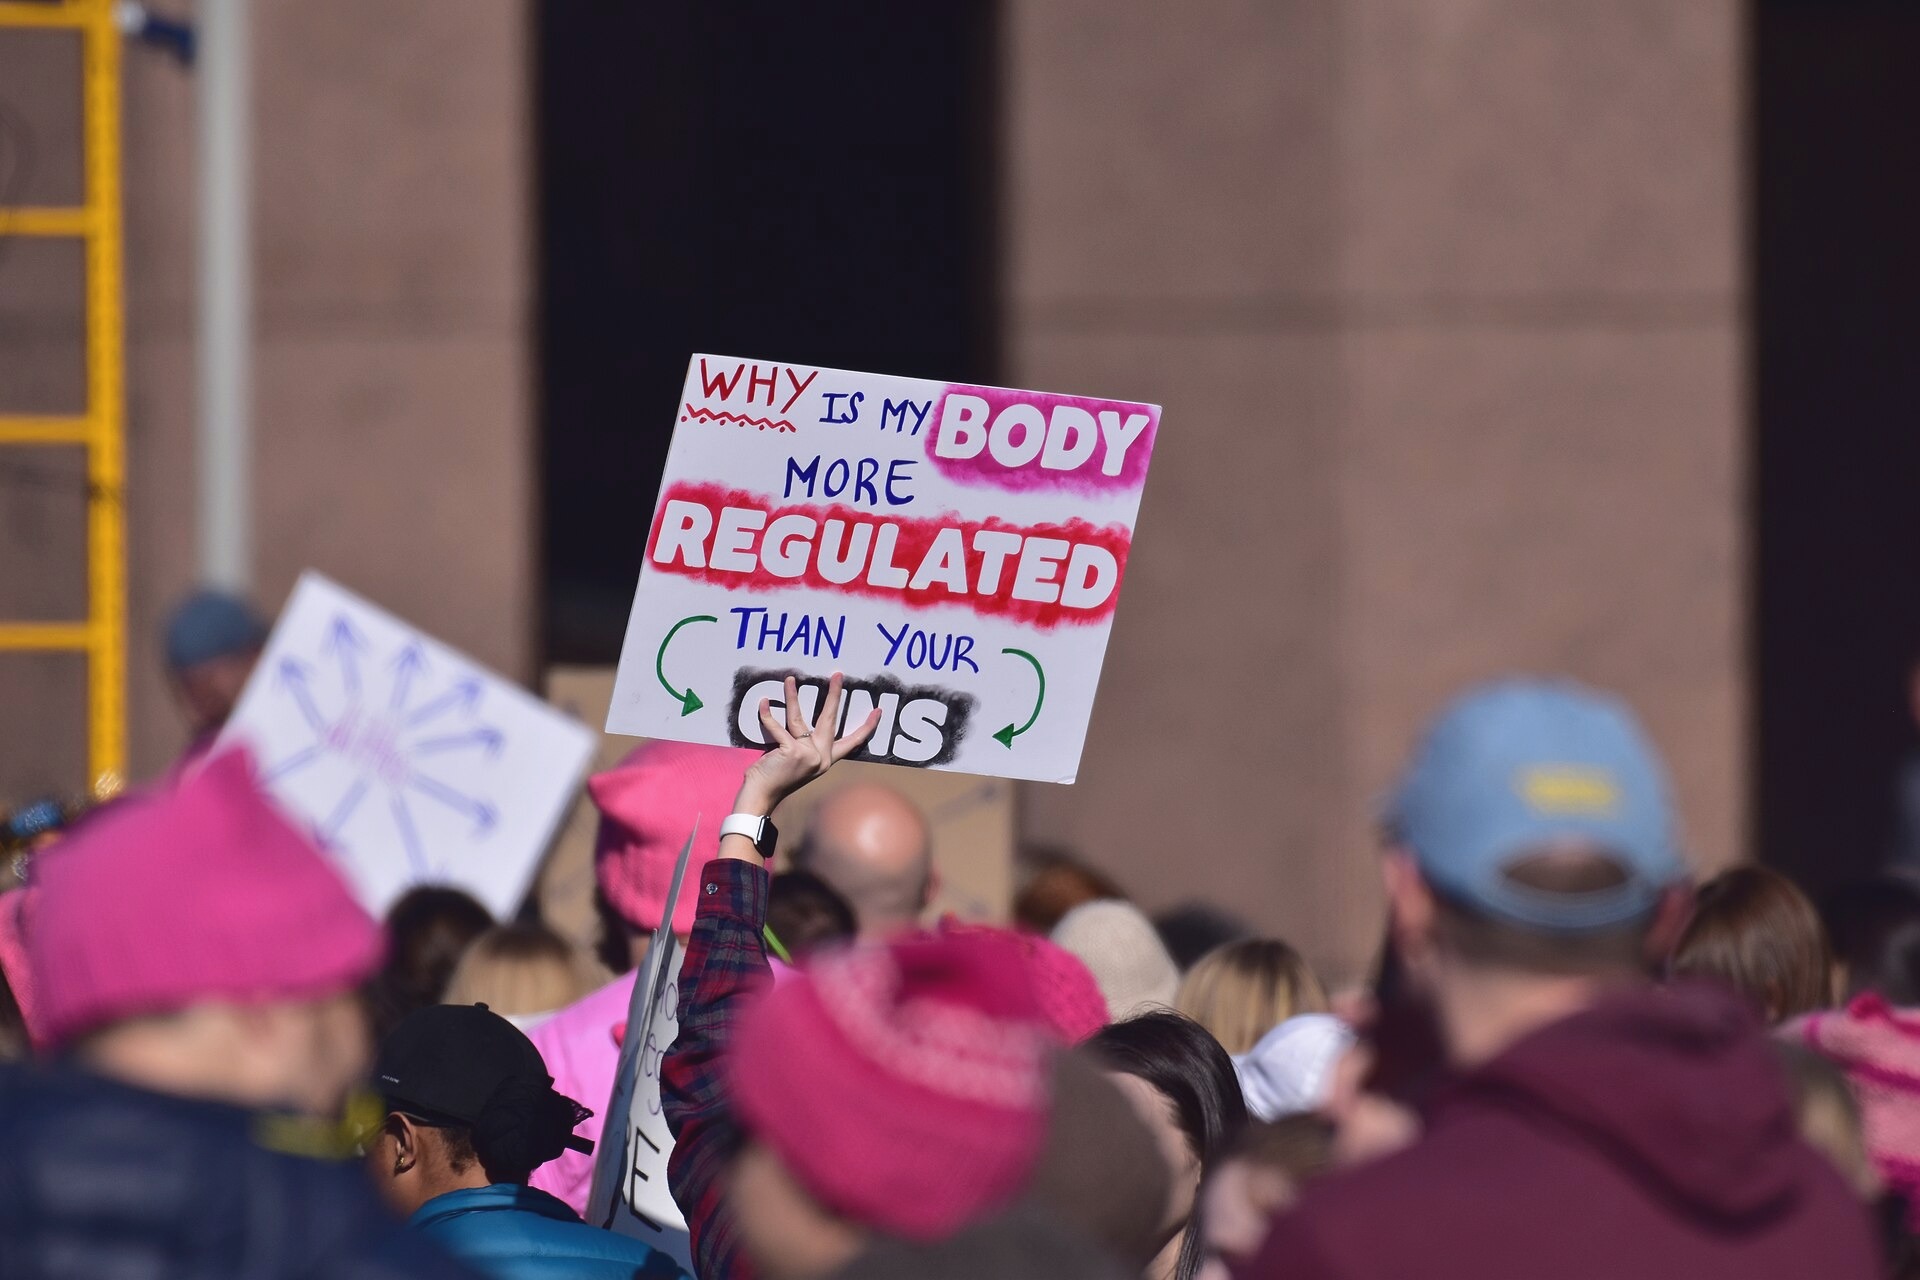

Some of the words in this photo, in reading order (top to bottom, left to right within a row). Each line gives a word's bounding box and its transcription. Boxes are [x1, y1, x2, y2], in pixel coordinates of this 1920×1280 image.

[700, 358, 818, 414] WHY
[819, 391, 865, 424] IS
[880, 398, 933, 436] MY
[935, 393, 1150, 477] BODY
[783, 454, 919, 506] MORE
[652, 499, 1119, 610] REGULATED
[730, 607, 846, 660] THAN
[876, 622, 980, 674] YOUR
